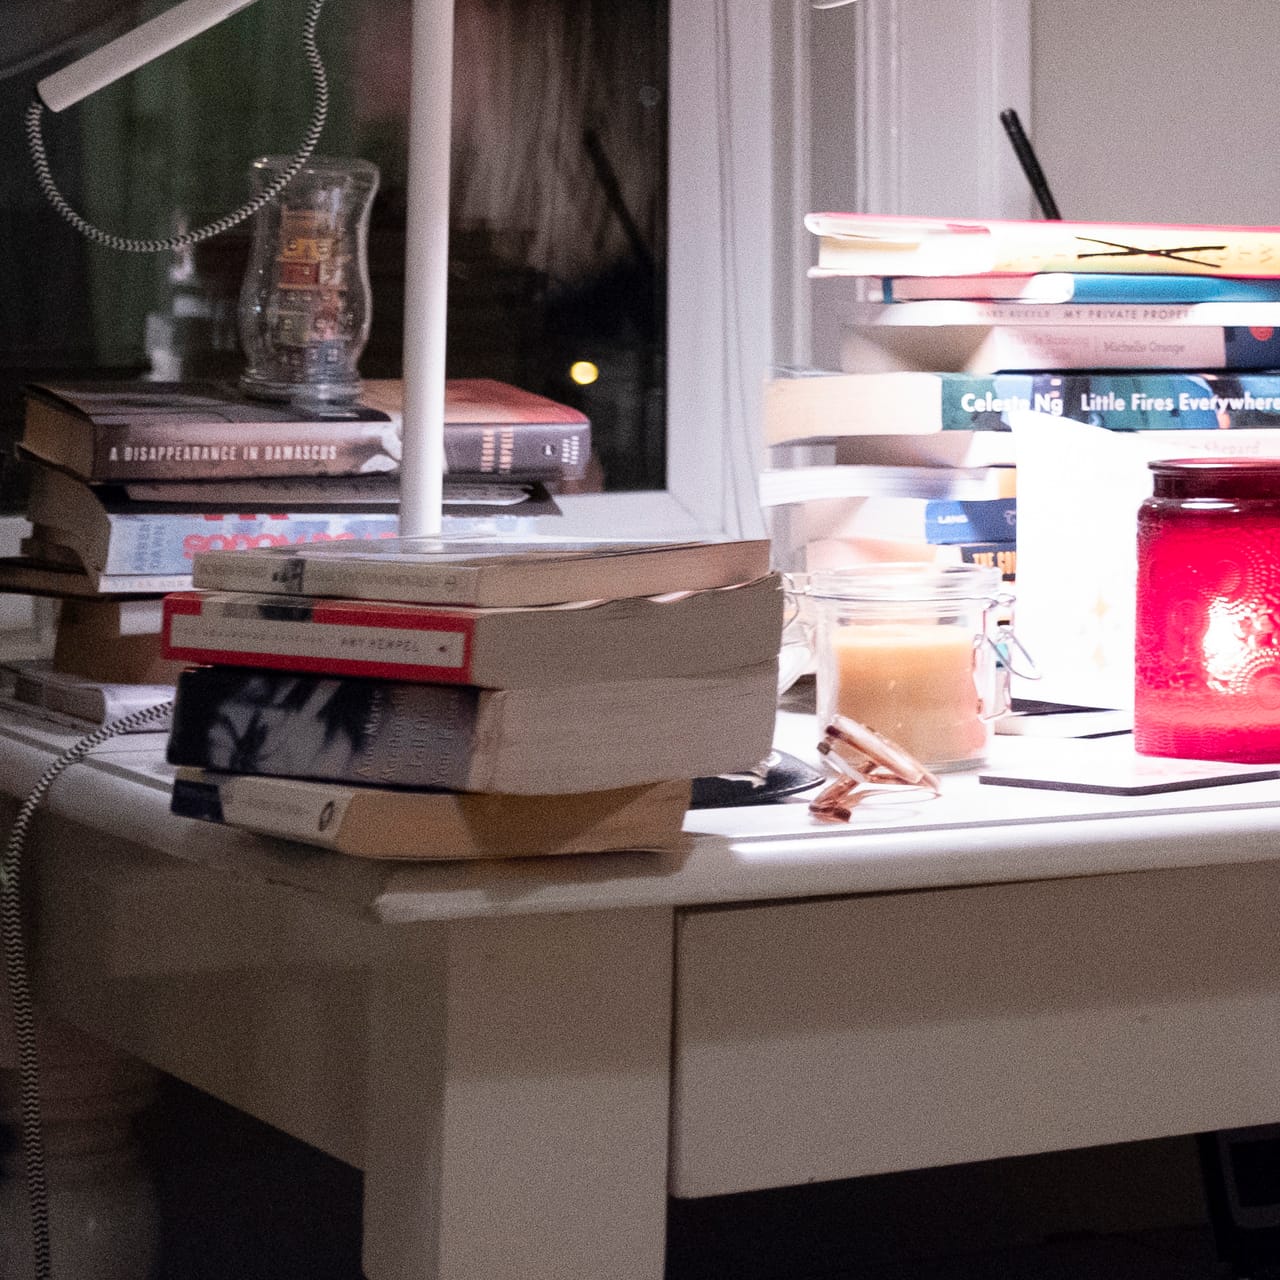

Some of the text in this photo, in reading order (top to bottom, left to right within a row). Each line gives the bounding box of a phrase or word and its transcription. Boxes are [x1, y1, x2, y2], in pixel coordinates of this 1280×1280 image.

[1063, 309, 1083, 320] MY
[1088, 308, 1138, 320] PRIVATE
[1149, 341, 1185, 356] Orange
[960, 391, 1064, 416] Celeste Ng
[1081, 393, 1126, 411] Little
[1131, 392, 1174, 411] Fires
[109, 444, 338, 462] A DISAPPEARANCE IN DAMASCUS
